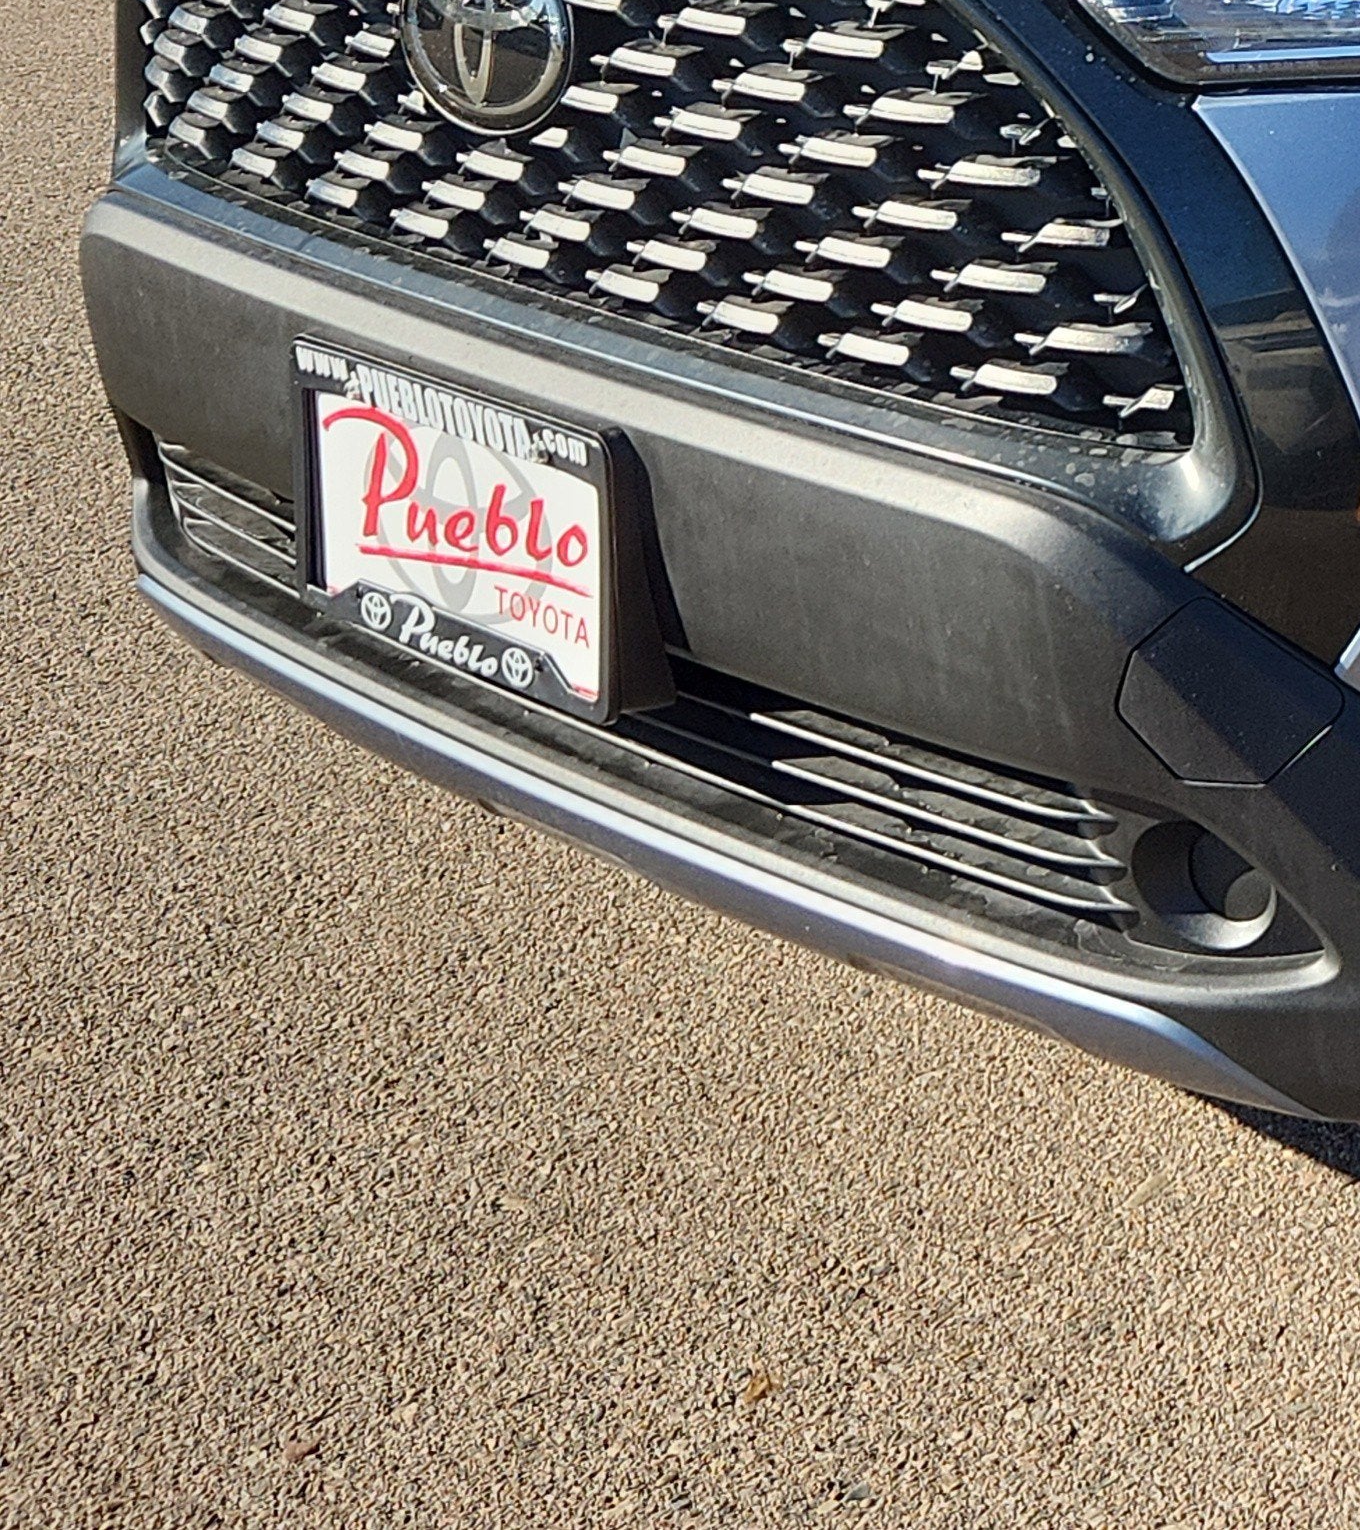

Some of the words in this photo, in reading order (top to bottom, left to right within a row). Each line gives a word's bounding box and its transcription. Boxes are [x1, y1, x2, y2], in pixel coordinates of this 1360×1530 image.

[322, 406, 590, 567] Pueblo
[389, 593, 499, 677] Pueblo
[494, 585, 591, 649] TOYOTA
